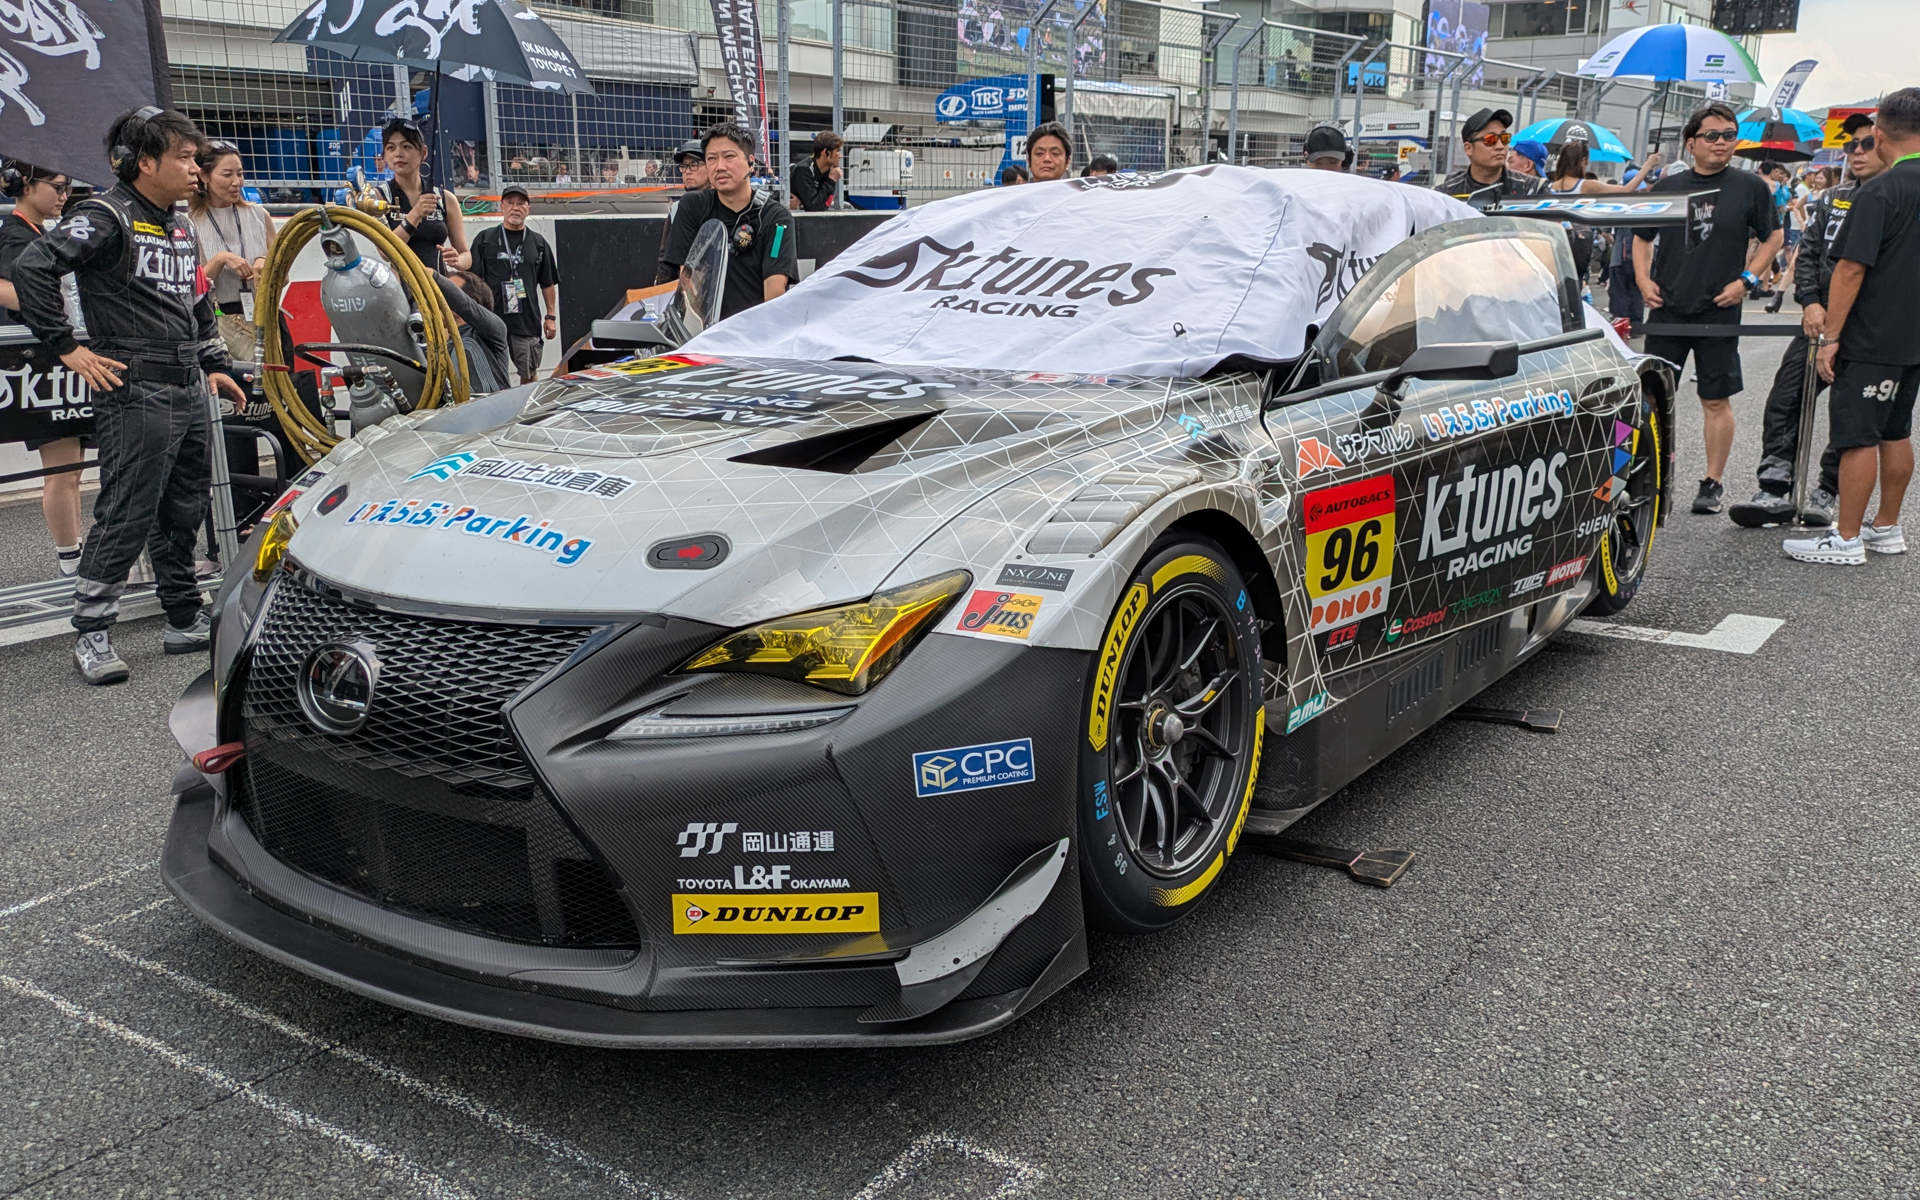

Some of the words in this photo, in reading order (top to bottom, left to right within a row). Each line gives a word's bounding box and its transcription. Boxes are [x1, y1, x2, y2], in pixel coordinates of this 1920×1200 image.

[522, 41, 571, 64] OKAYAMA
[530, 57, 577, 79] TOYOPET
[976, 92, 999, 106] TRS
[902, 244, 1177, 307] ktunes
[930, 295, 1080, 318] RACING
[634, 367, 957, 400] ktunes
[639, 390, 815, 408] RACING
[51, 406, 94, 421] RAC
[1422, 401, 1494, 440] いえらぶ
[1493, 390, 1573, 422] Parking
[1336, 423, 1414, 462] サンマルク
[463, 459, 632, 499] 岡山土地倉庫
[349, 500, 449, 524] いえらぶ
[1325, 489, 1390, 515] AUTOBACS
[1417, 451, 1568, 559] ktunes
[445, 506, 592, 565] Parking
[1320, 519, 1382, 592] 96
[1446, 534, 1532, 581] RACING
[1548, 560, 1583, 582] MOTUL
[1310, 586, 1383, 630] PONOS
[1402, 606, 1448, 634] Castrol
[1328, 624, 1358, 645] ETS
[1095, 588, 1142, 723] DUNLOP
[960, 745, 1028, 777] CPC
[962, 774, 996, 786] PREMIUM
[997, 769, 1029, 781] COATING
[742, 830, 835, 853] 岡山通運
[677, 878, 733, 890] TOYOTA
[733, 865, 791, 890] L&F
[790, 878, 851, 889] OKAYAMA
[713, 905, 865, 922] DUNLOP
